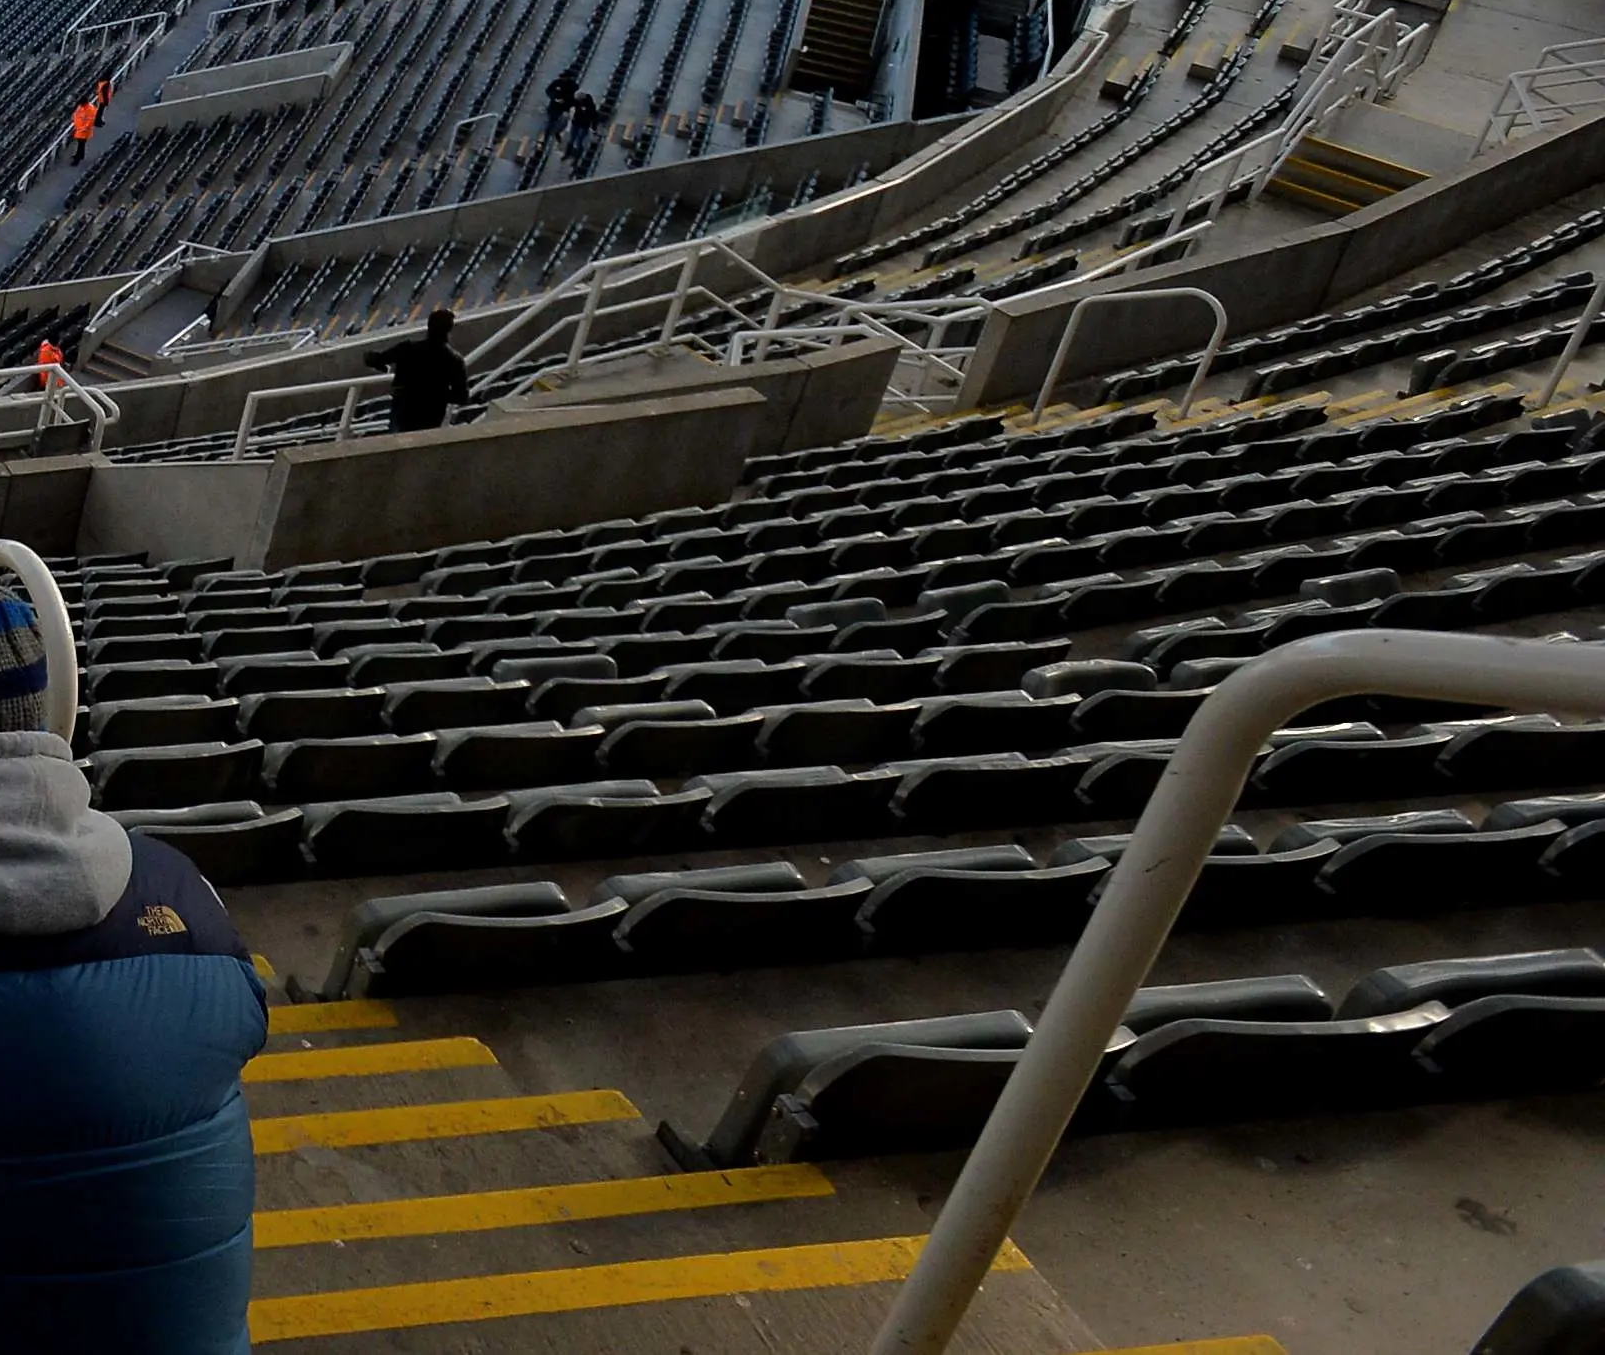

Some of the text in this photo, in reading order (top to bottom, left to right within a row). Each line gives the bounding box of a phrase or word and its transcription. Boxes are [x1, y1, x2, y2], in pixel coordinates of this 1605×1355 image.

[145, 905, 162, 917] THE
[137, 916, 166, 927] NORTH
[148, 925, 172, 936] FACE
